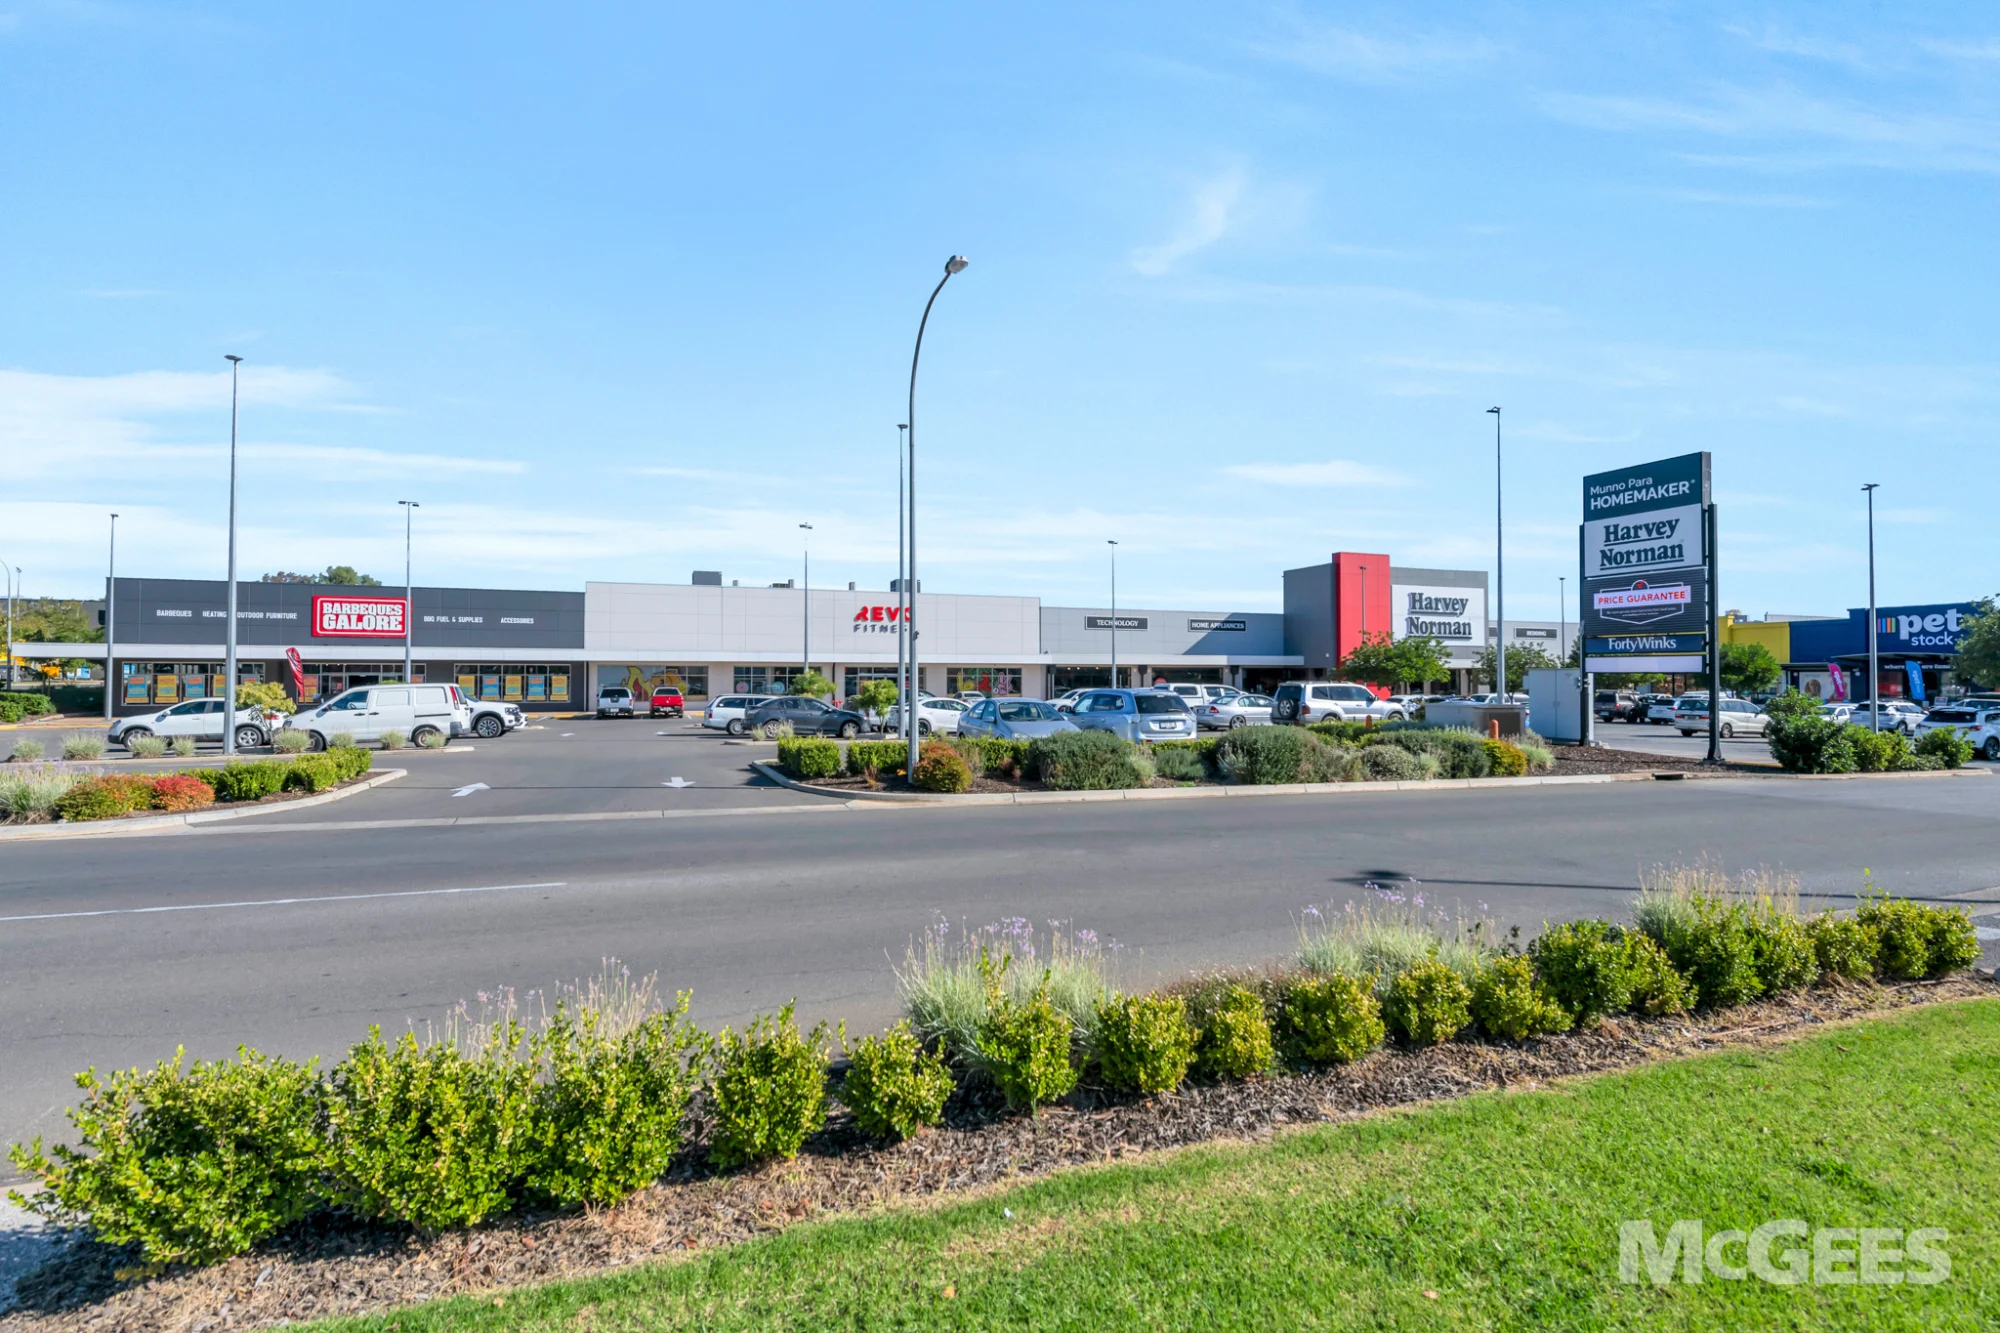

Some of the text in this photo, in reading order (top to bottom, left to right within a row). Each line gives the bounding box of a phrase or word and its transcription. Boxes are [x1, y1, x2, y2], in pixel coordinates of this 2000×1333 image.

[1590, 477, 1653, 495] Munno Para
[1590, 480, 1690, 510] HOMEMAKER
[1603, 518, 1680, 543] Harvey
[1599, 543, 1684, 567] Norman
[1408, 592, 1469, 617] Harvey
[1598, 590, 1686, 604] PRICE GUARANTEE
[156, 609, 193, 617] BARBEQUES
[202, 610, 298, 620] HEATING OUTDOOR FURNITURE
[323, 602, 402, 616] BARBEQUES
[323, 614, 402, 630] GALORE
[436, 615, 450, 623] FUEL
[458, 616, 484, 624] SUPPLIES
[1096, 619, 1139, 627] TECHNOLOGY
[1191, 621, 1245, 630] HOME APPLIANCES
[1405, 616, 1472, 636] Norman
[1897, 608, 1963, 640] pet
[853, 623, 908, 634] FITNE
[1608, 636, 1677, 652] FortyWinks
[1911, 631, 1954, 646] stock
